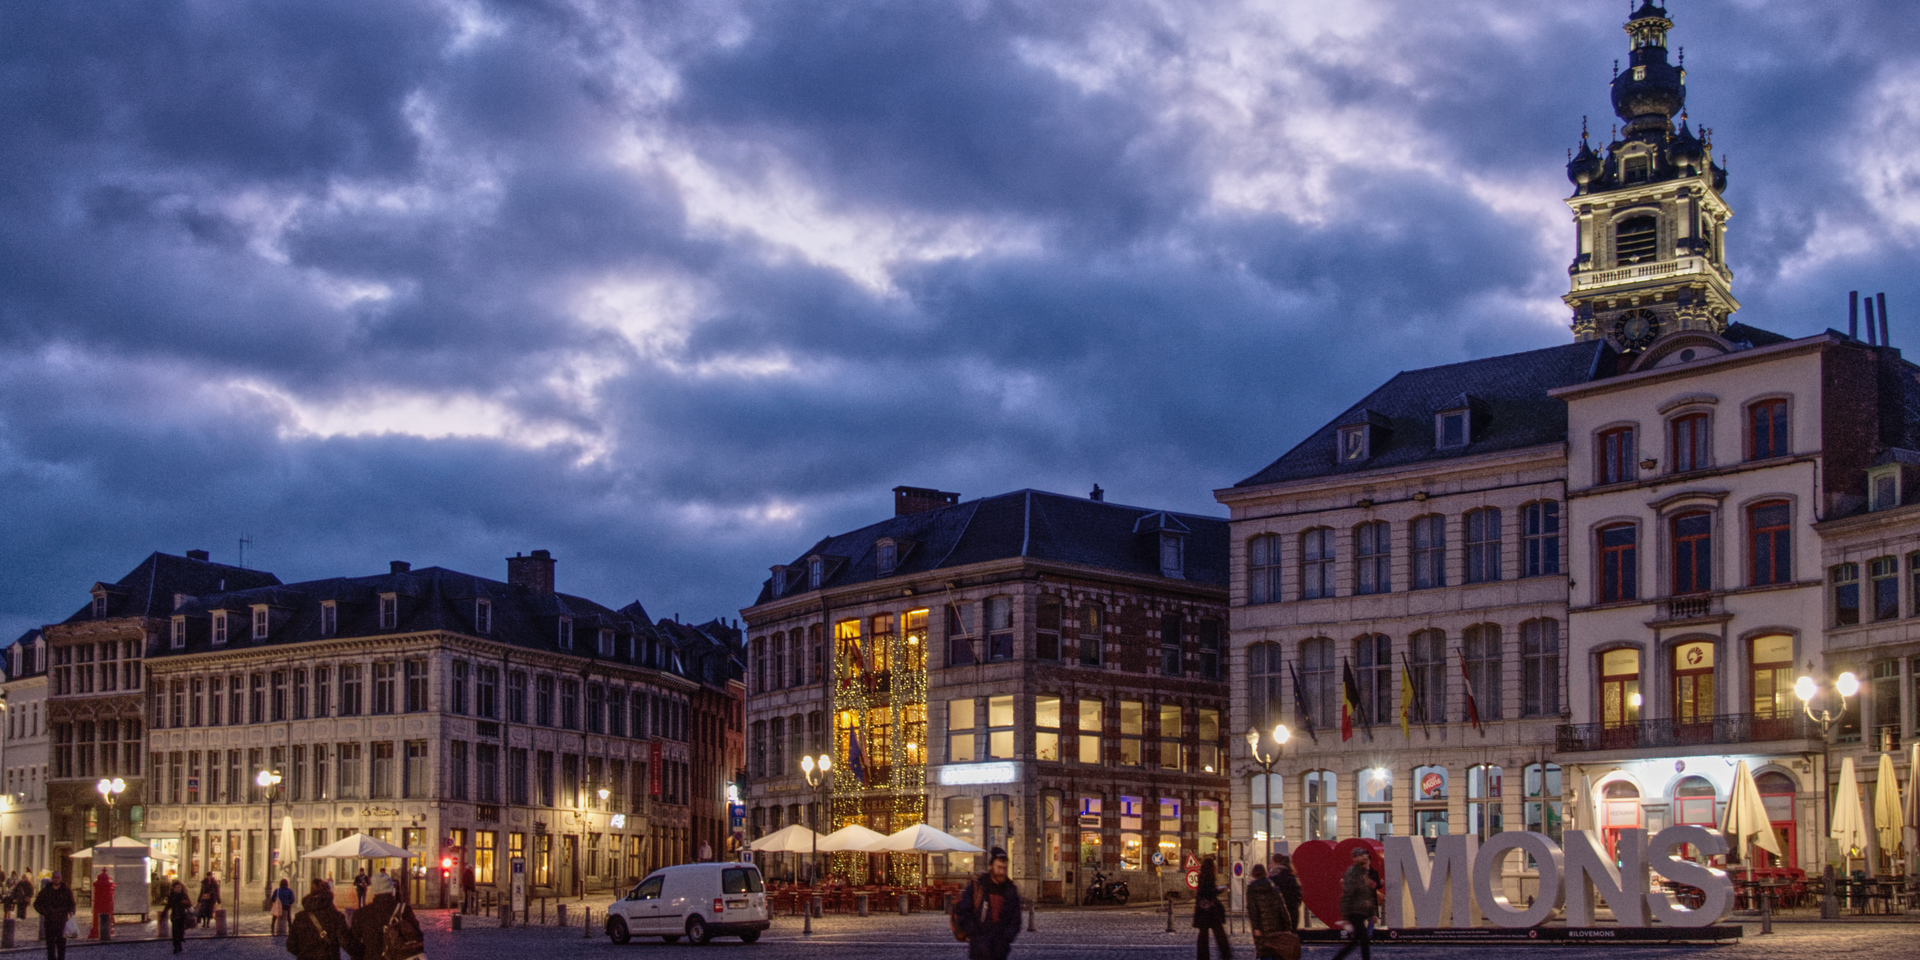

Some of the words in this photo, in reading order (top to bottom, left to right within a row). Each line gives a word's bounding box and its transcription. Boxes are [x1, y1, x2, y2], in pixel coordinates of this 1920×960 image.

[1423, 778, 1442, 790] Mons
[852, 799, 909, 810] XCELSIOR
[1189, 875, 1198, 884] 30
[1384, 825, 1733, 929] MONS
